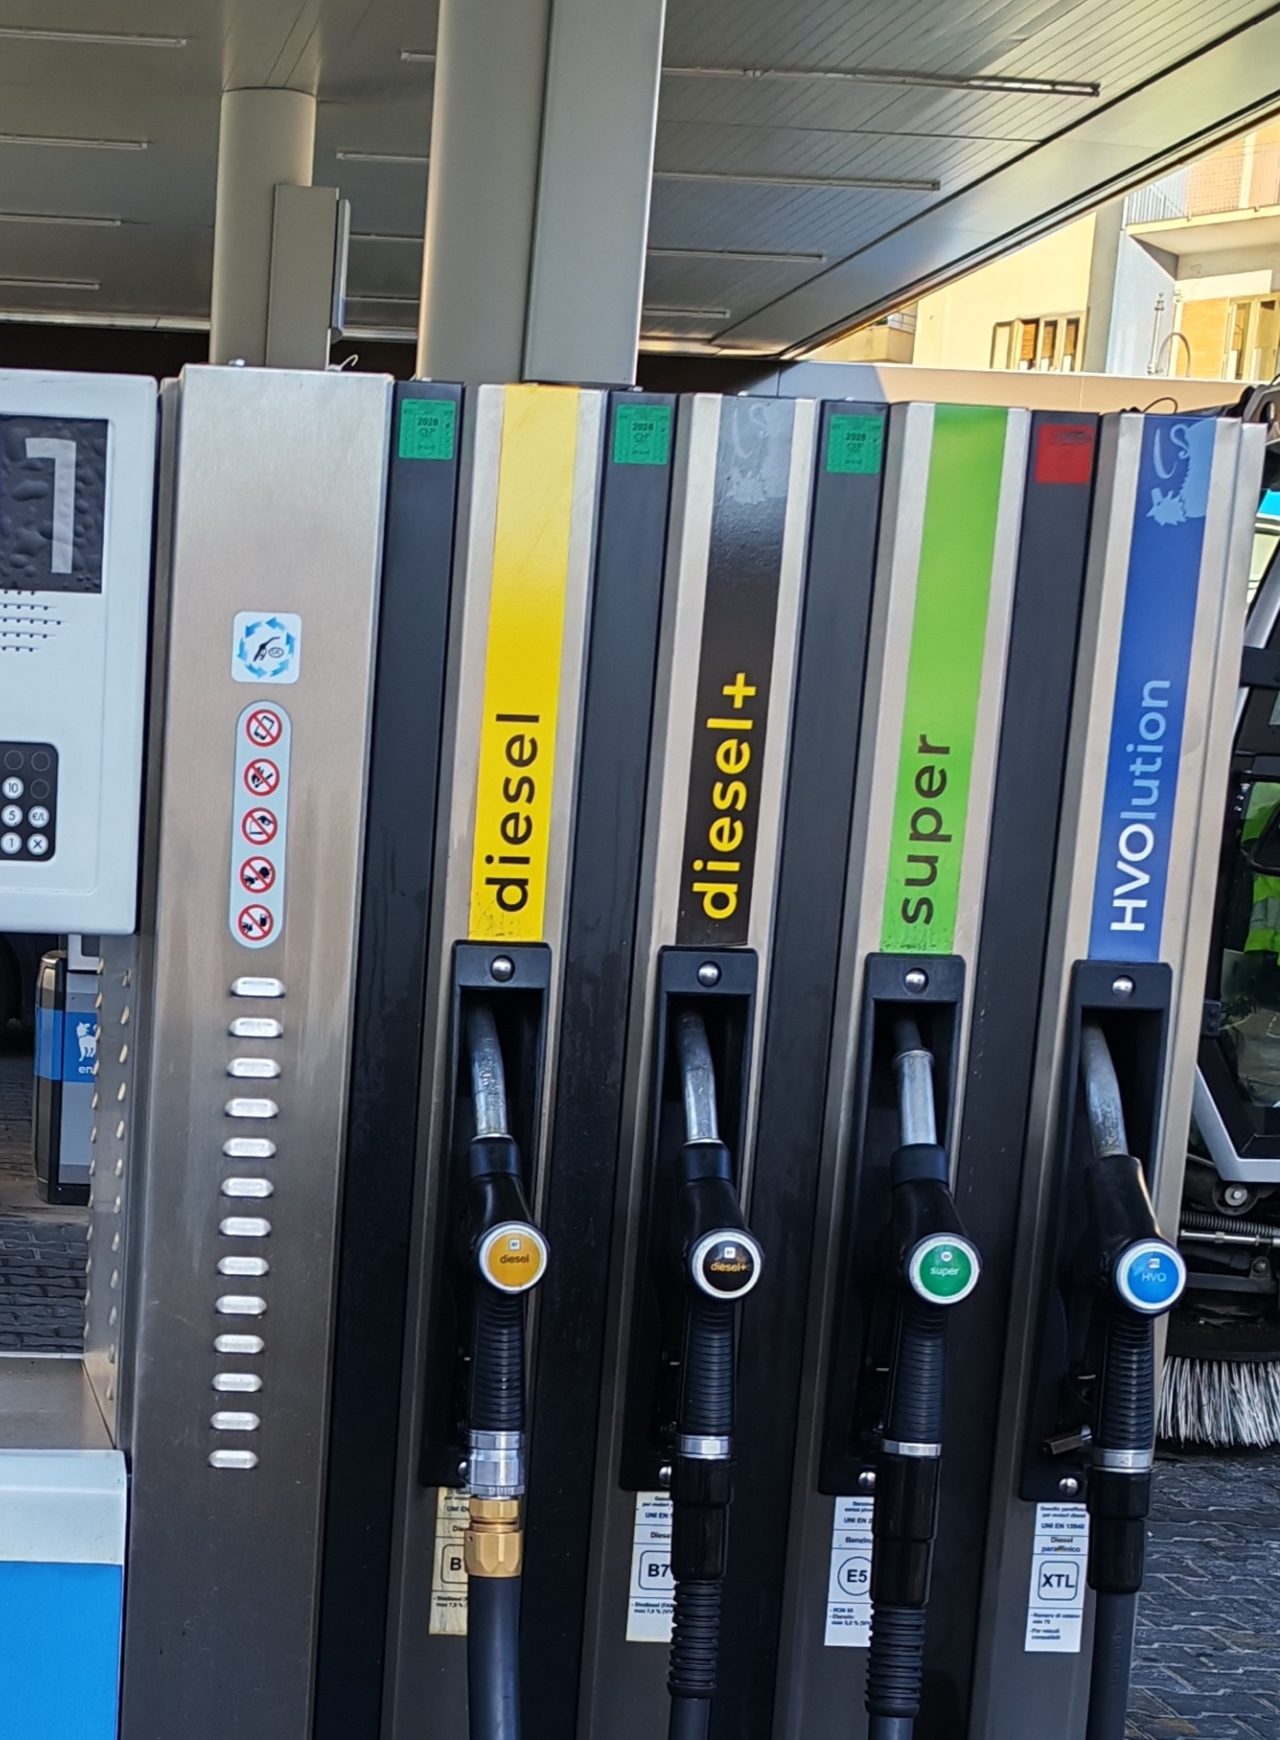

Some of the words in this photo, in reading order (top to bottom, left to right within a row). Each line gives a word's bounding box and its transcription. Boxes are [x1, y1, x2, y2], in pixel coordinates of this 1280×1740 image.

[25, 438, 77, 574] 1
[7, 782, 19, 794] 10
[692, 672, 757, 920] diesel+
[1110, 679, 1171, 931] HVOlution
[8, 810, 16, 821] 5
[485, 713, 540, 913] diesel
[901, 734, 953, 926] super
[78, 1066, 95, 1075] en
[499, 1253, 530, 1264] diesel
[710, 1261, 747, 1272] diesel+
[929, 1267, 960, 1277] super
[1141, 1272, 1167, 1282] HVO
[450, 1557, 462, 1571] B
[648, 1563, 670, 1578] B7
[846, 1569, 868, 1583] E5
[1041, 1573, 1075, 1588] XTL
